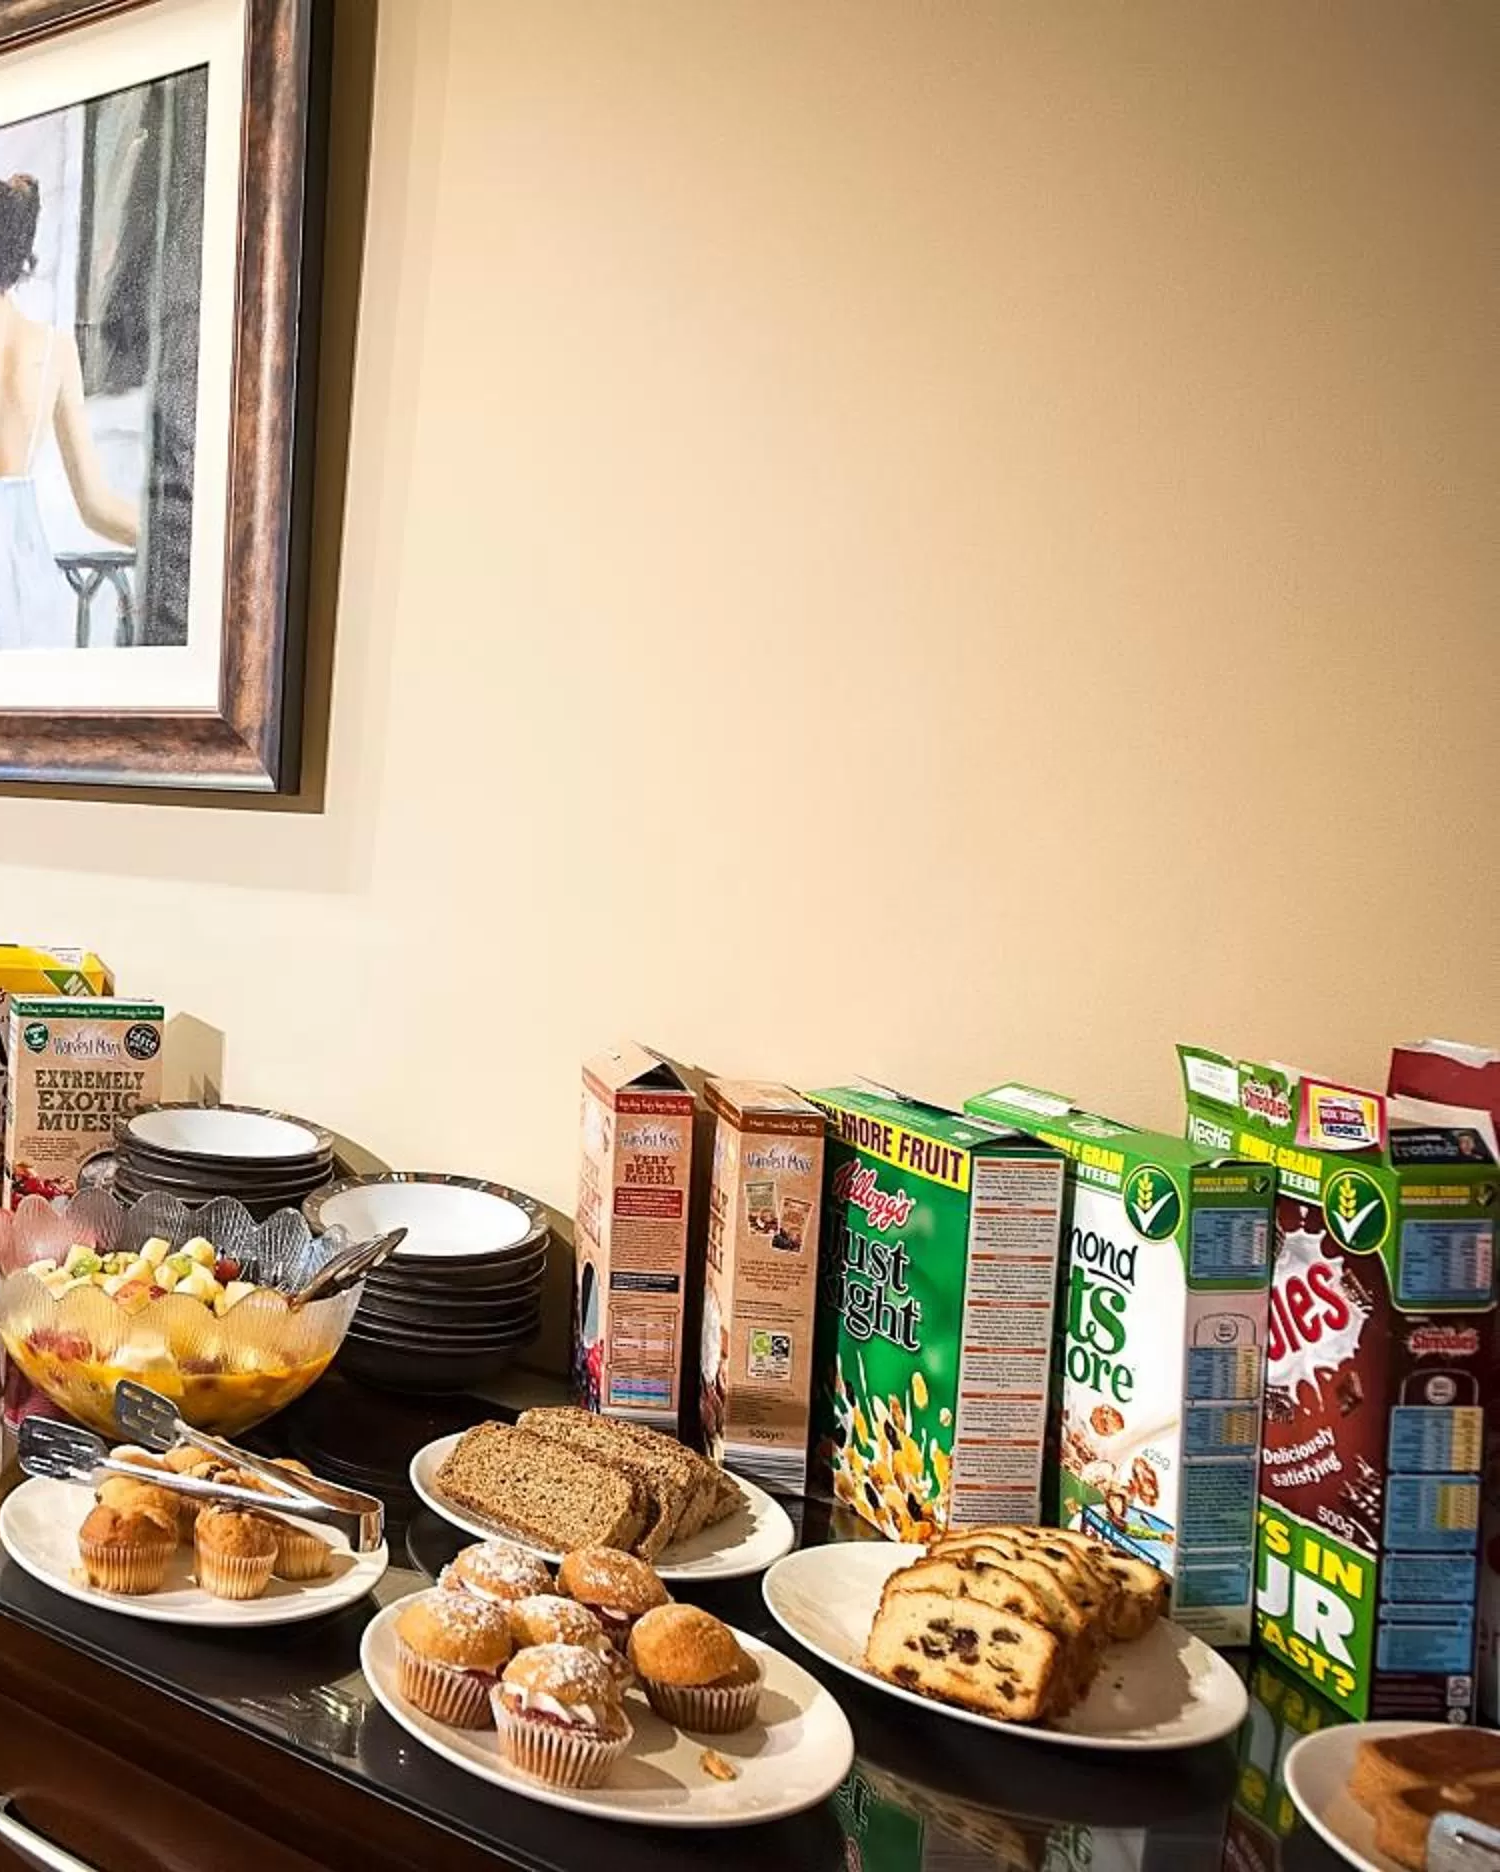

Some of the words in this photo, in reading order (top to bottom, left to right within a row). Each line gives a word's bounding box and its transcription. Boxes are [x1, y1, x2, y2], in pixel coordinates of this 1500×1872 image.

[34, 1069, 146, 1090] EXTREMELY
[37, 1090, 141, 1114] EXOTIC
[37, 1111, 120, 1132] MUES
[839, 1110, 894, 1158] MORE
[899, 1131, 965, 1184] FRUIT
[1261, 1425, 1336, 1465] Deliciously
[1317, 1503, 1355, 1541] 500g
[1303, 1537, 1364, 1600] IN
